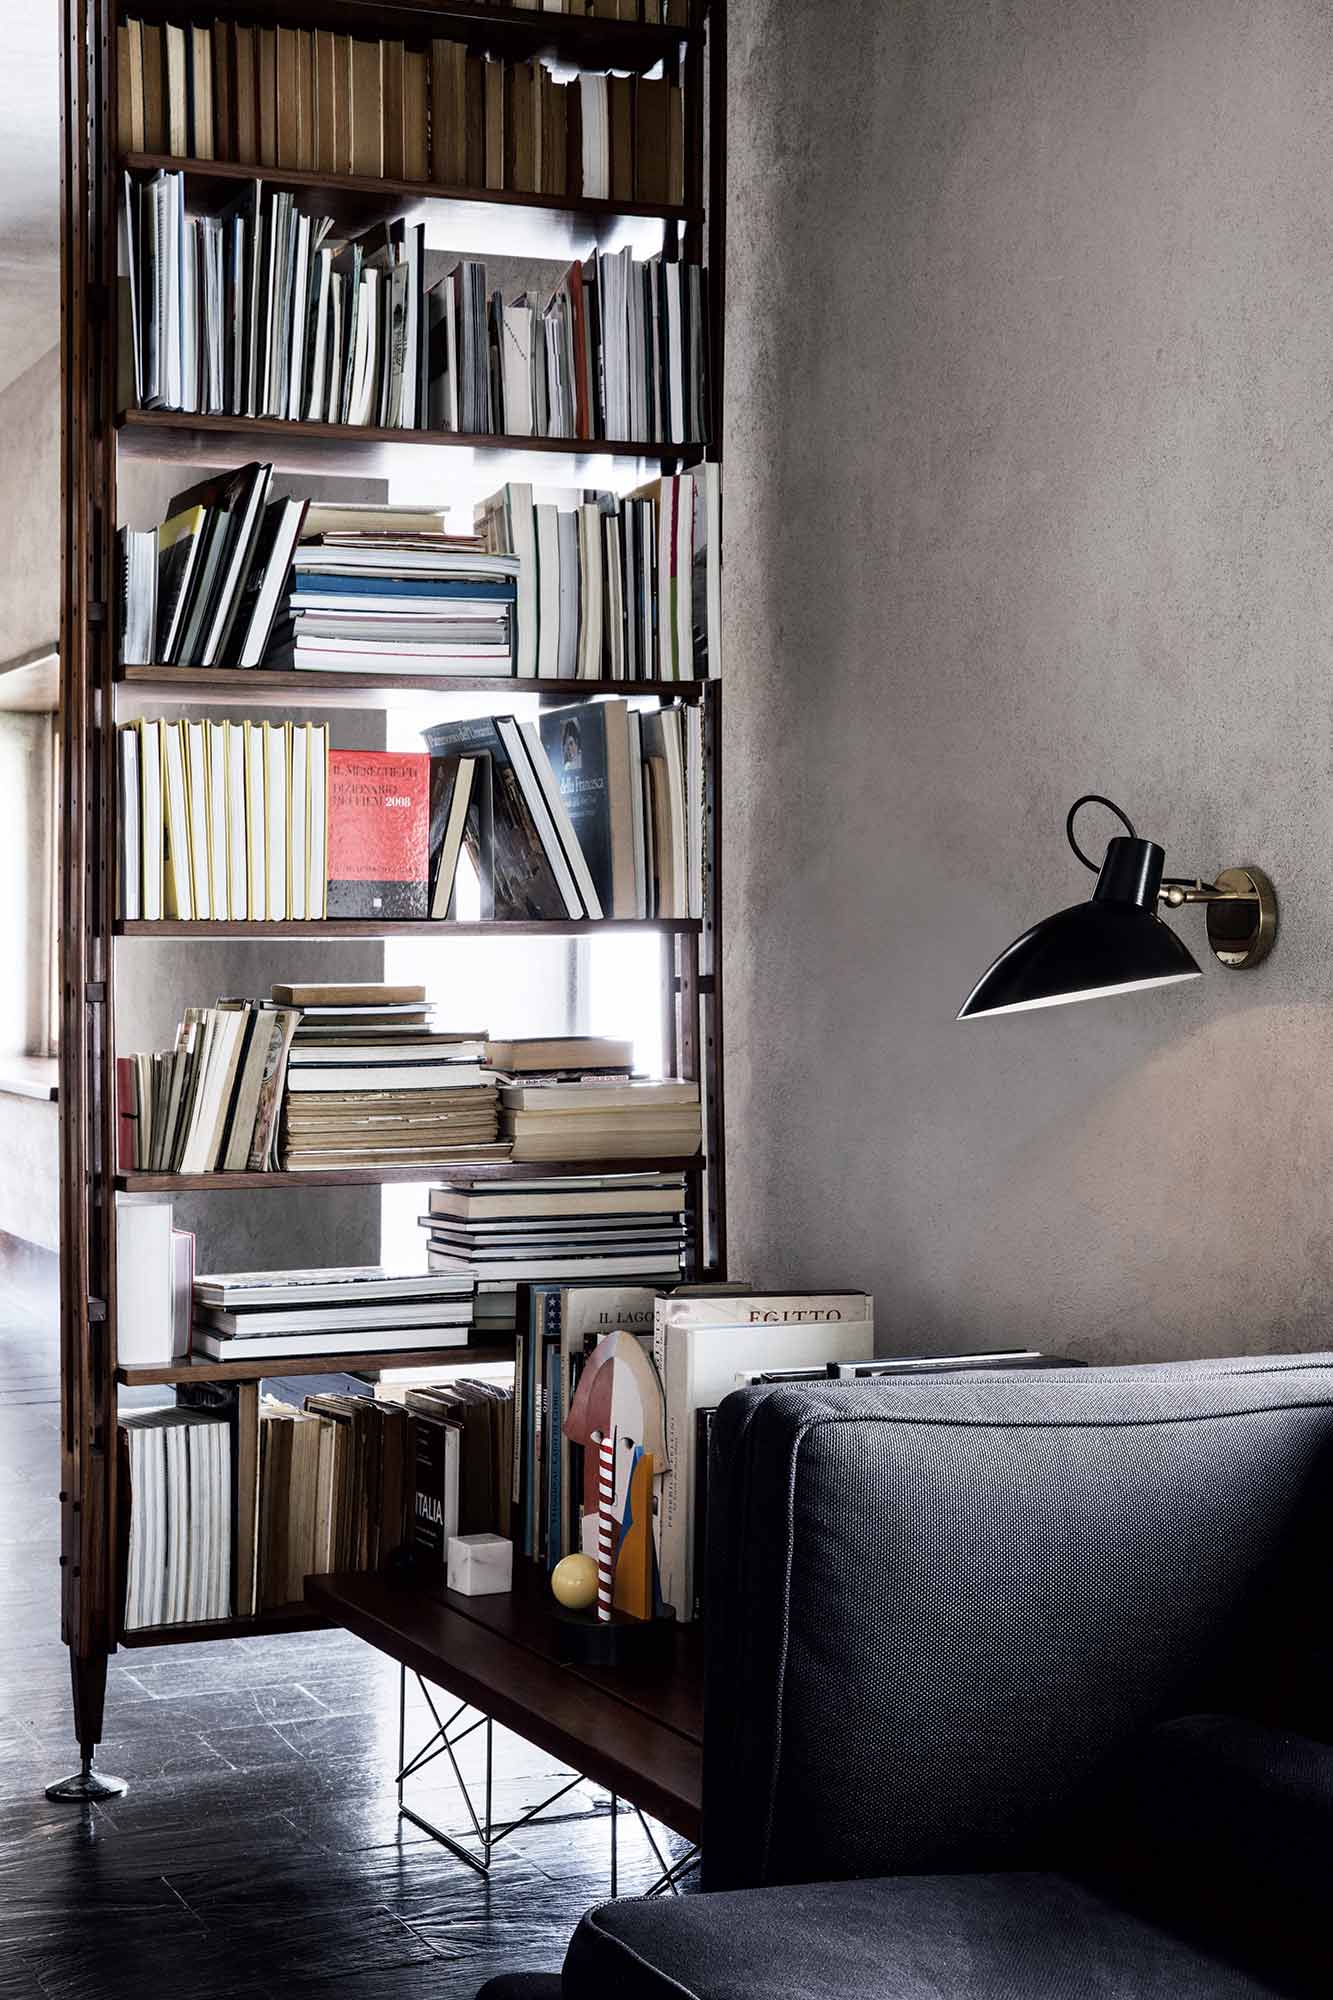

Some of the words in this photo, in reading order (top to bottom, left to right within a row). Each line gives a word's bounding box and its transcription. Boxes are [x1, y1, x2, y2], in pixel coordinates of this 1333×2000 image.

[385, 796, 411, 807] 2008
[600, 1312, 613, 1324] IL
[749, 1309, 842, 1323] EGITTO
[415, 1491, 444, 1526] ITALIA
